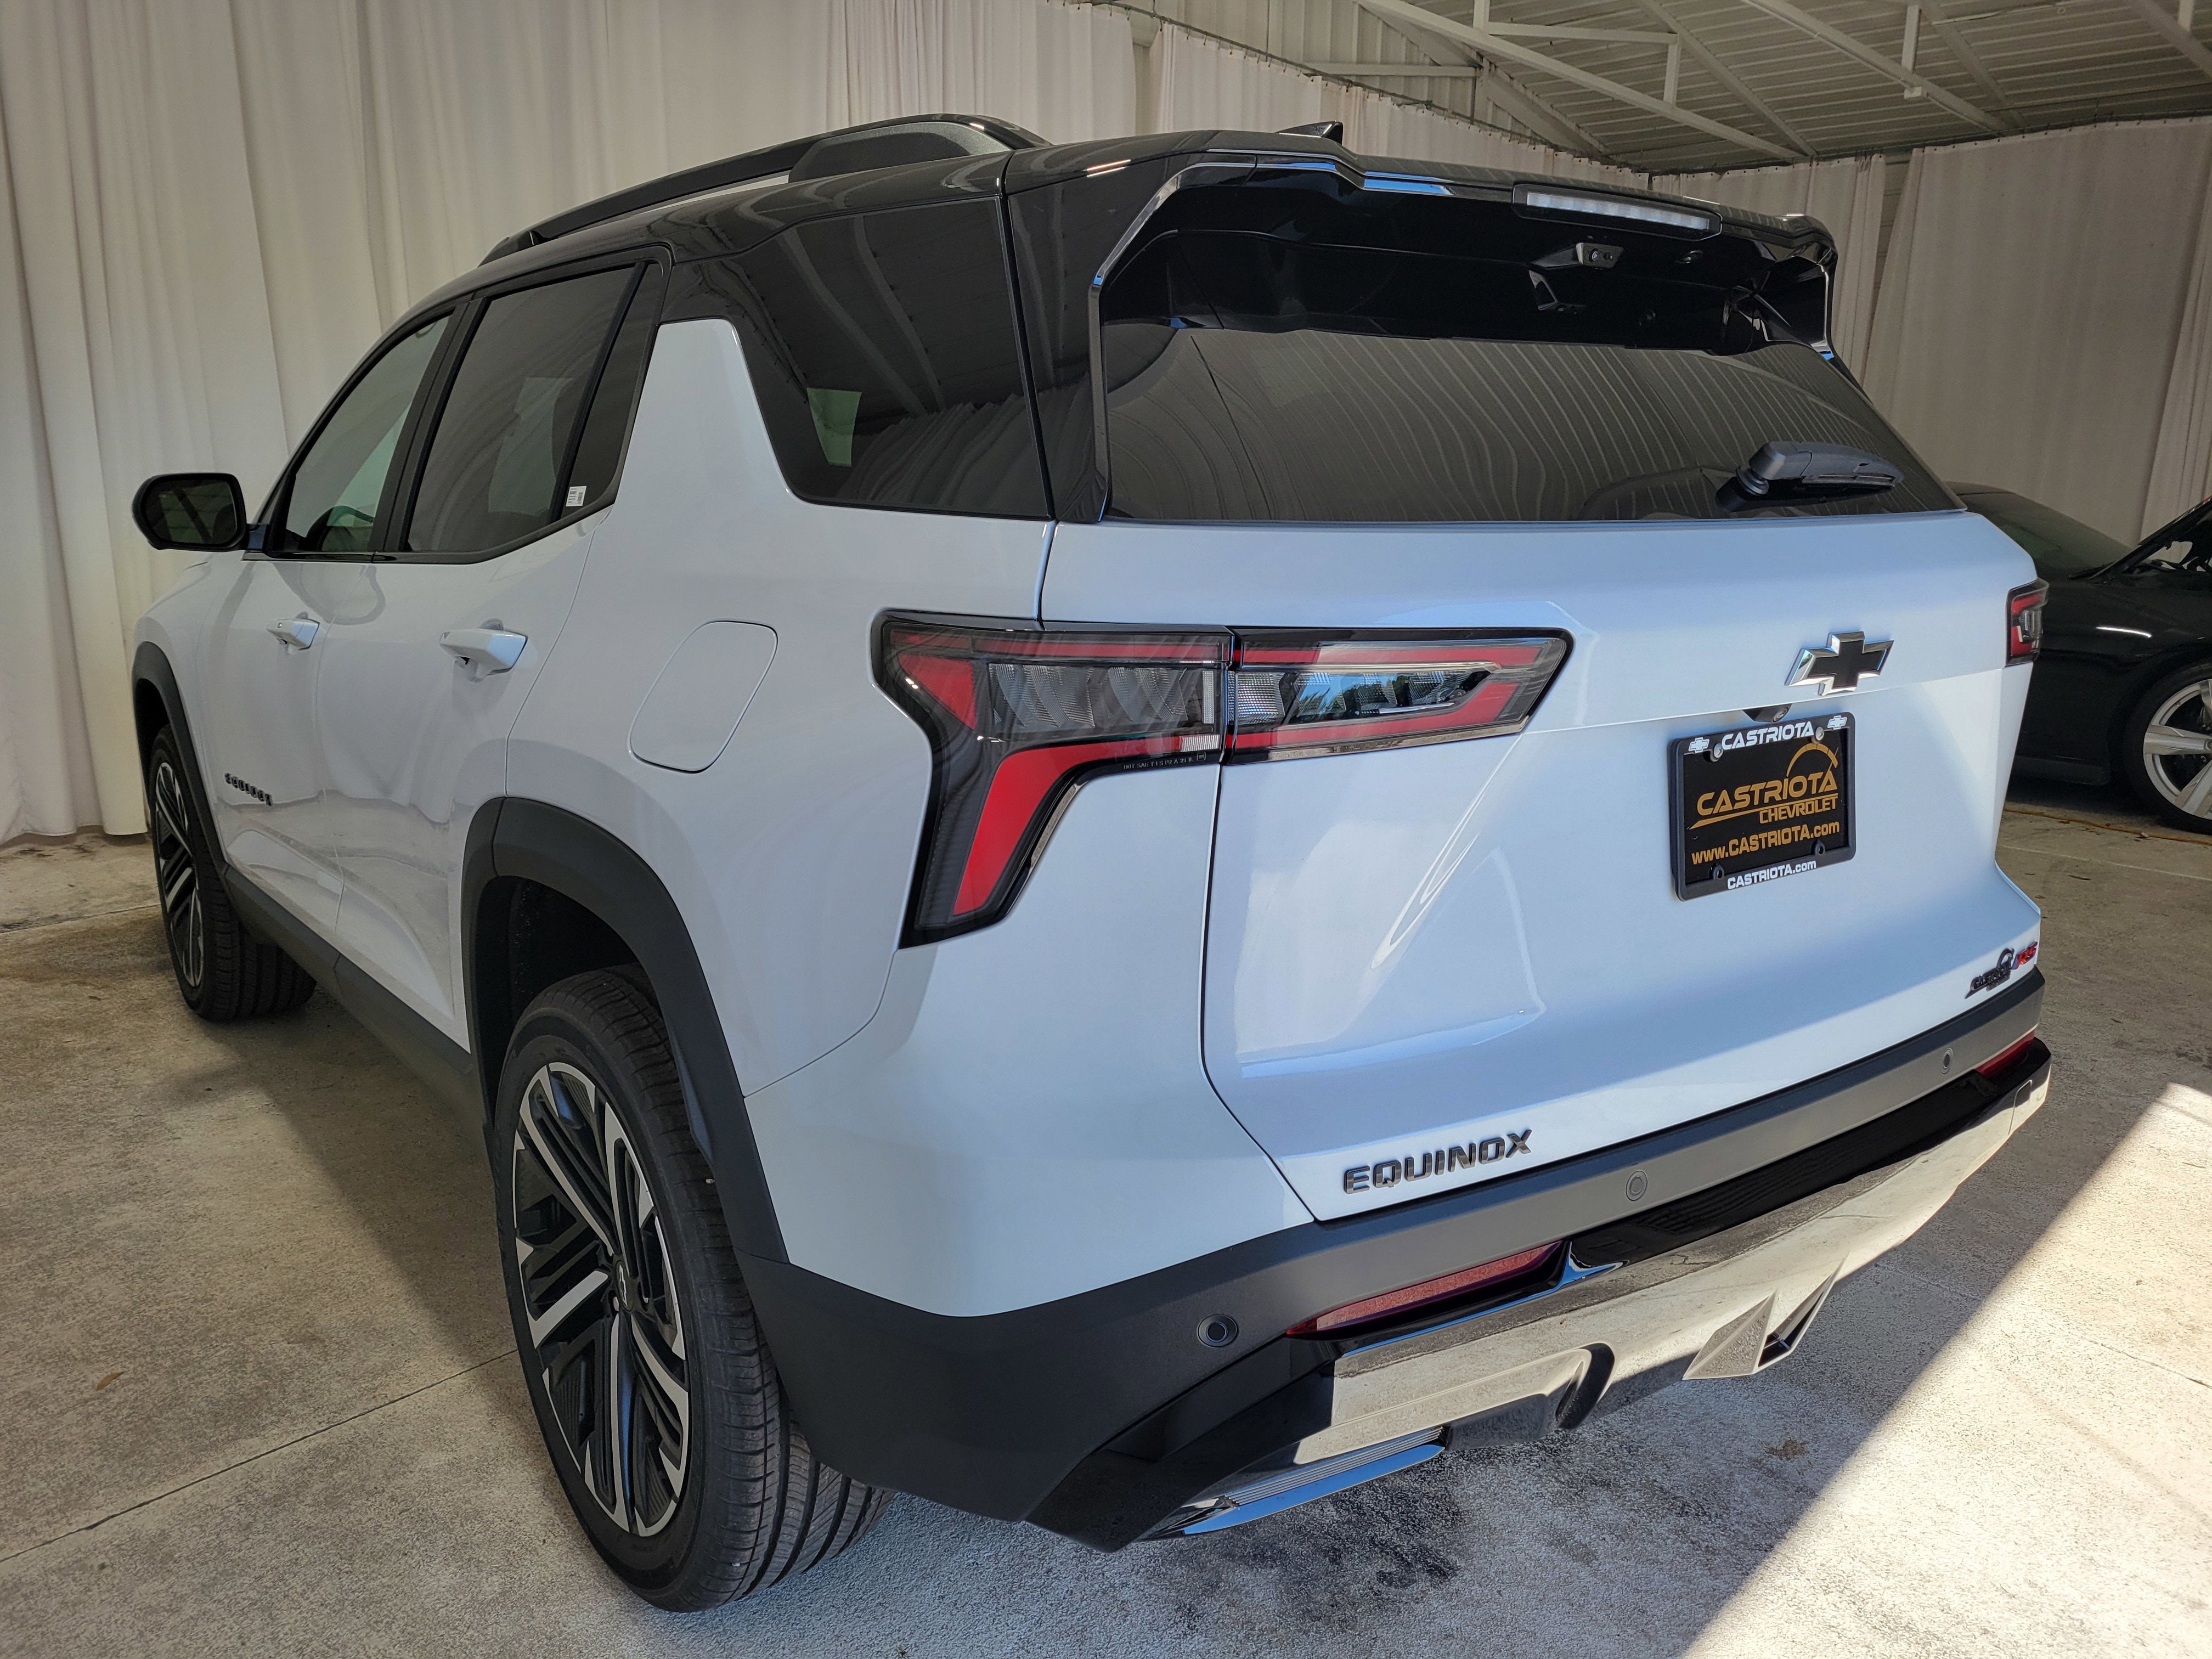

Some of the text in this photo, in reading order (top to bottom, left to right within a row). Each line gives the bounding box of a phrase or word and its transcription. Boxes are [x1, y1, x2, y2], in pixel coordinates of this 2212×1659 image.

[1721, 721, 1814, 751] CASTRIOTA
[1697, 770, 1838, 816] CASTRIOTA
[1759, 795, 1838, 824] CHEVROLET
[1691, 821, 1840, 865] www.CASTRIOTA.com
[1727, 860, 1816, 890] CASTRIOTA.com
[1343, 1129, 1532, 1194] EQUINOX
